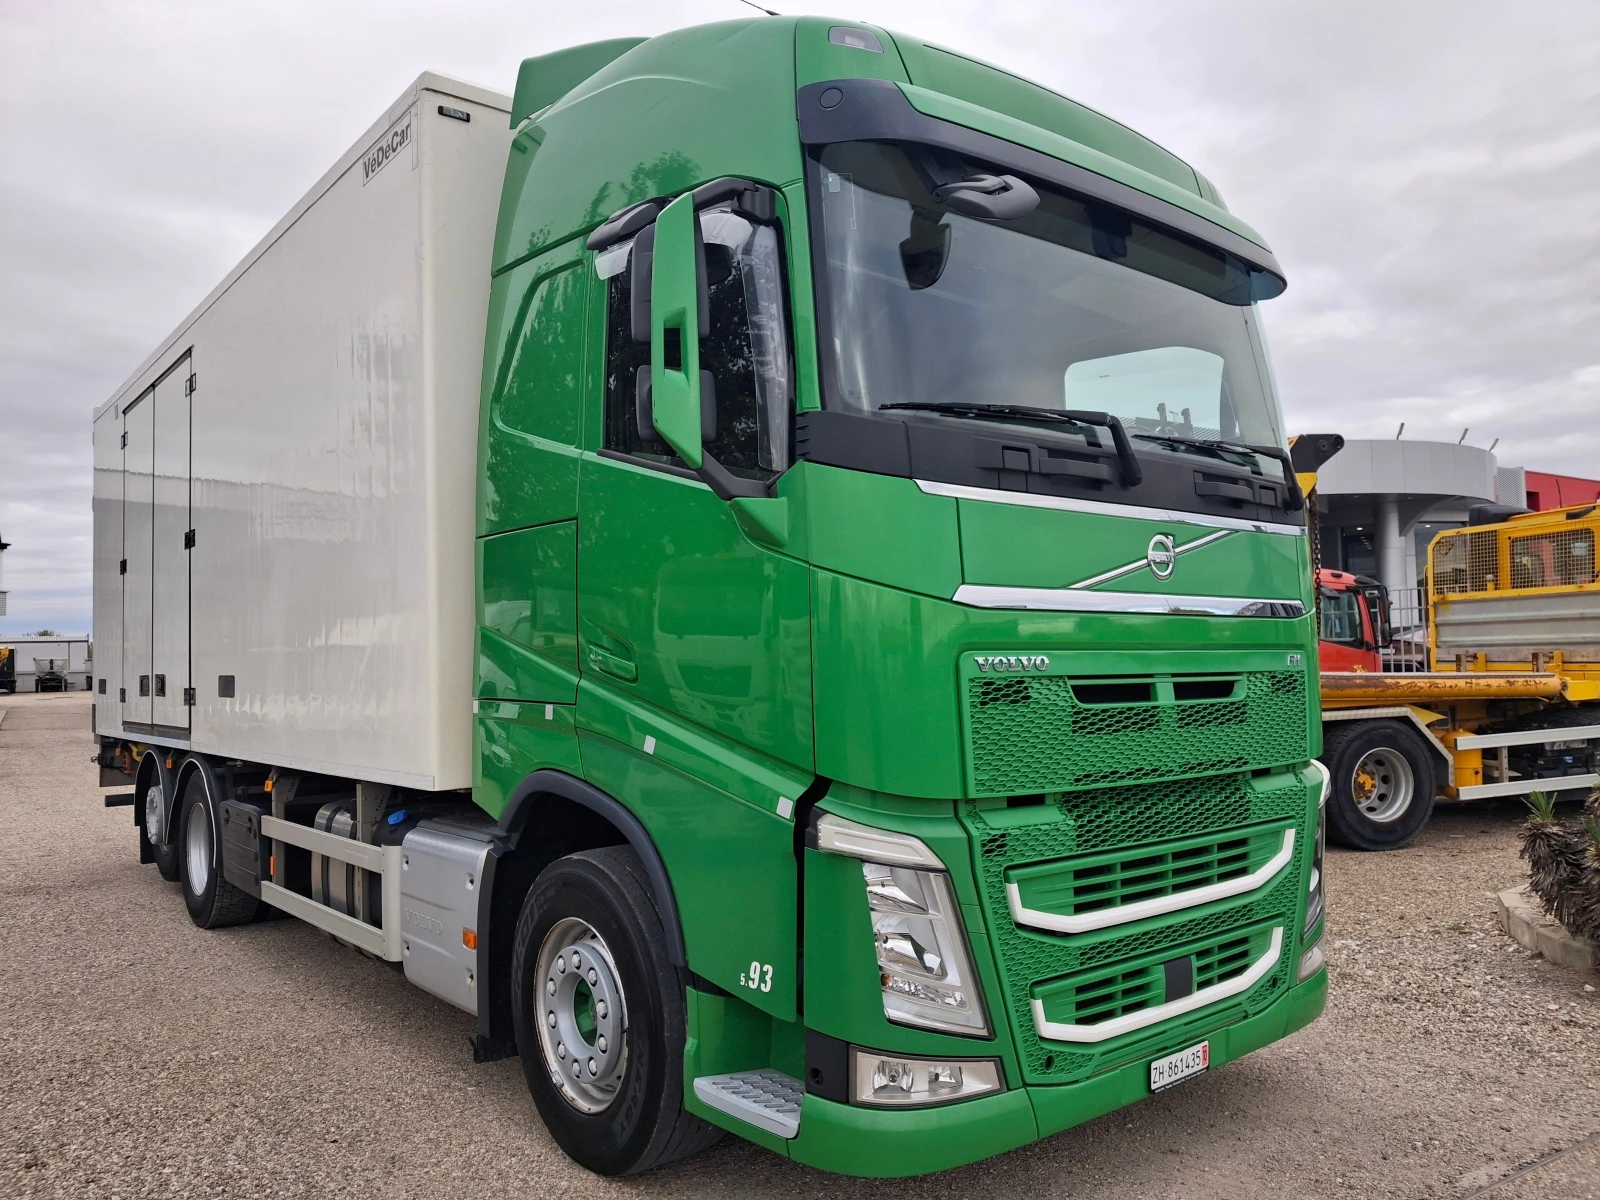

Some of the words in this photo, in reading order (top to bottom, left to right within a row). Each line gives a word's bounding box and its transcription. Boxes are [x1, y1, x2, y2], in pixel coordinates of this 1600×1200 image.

[363, 123, 410, 179] VéDéCar
[975, 656, 1050, 672] VOLVO
[403, 907, 443, 936] VOLVO
